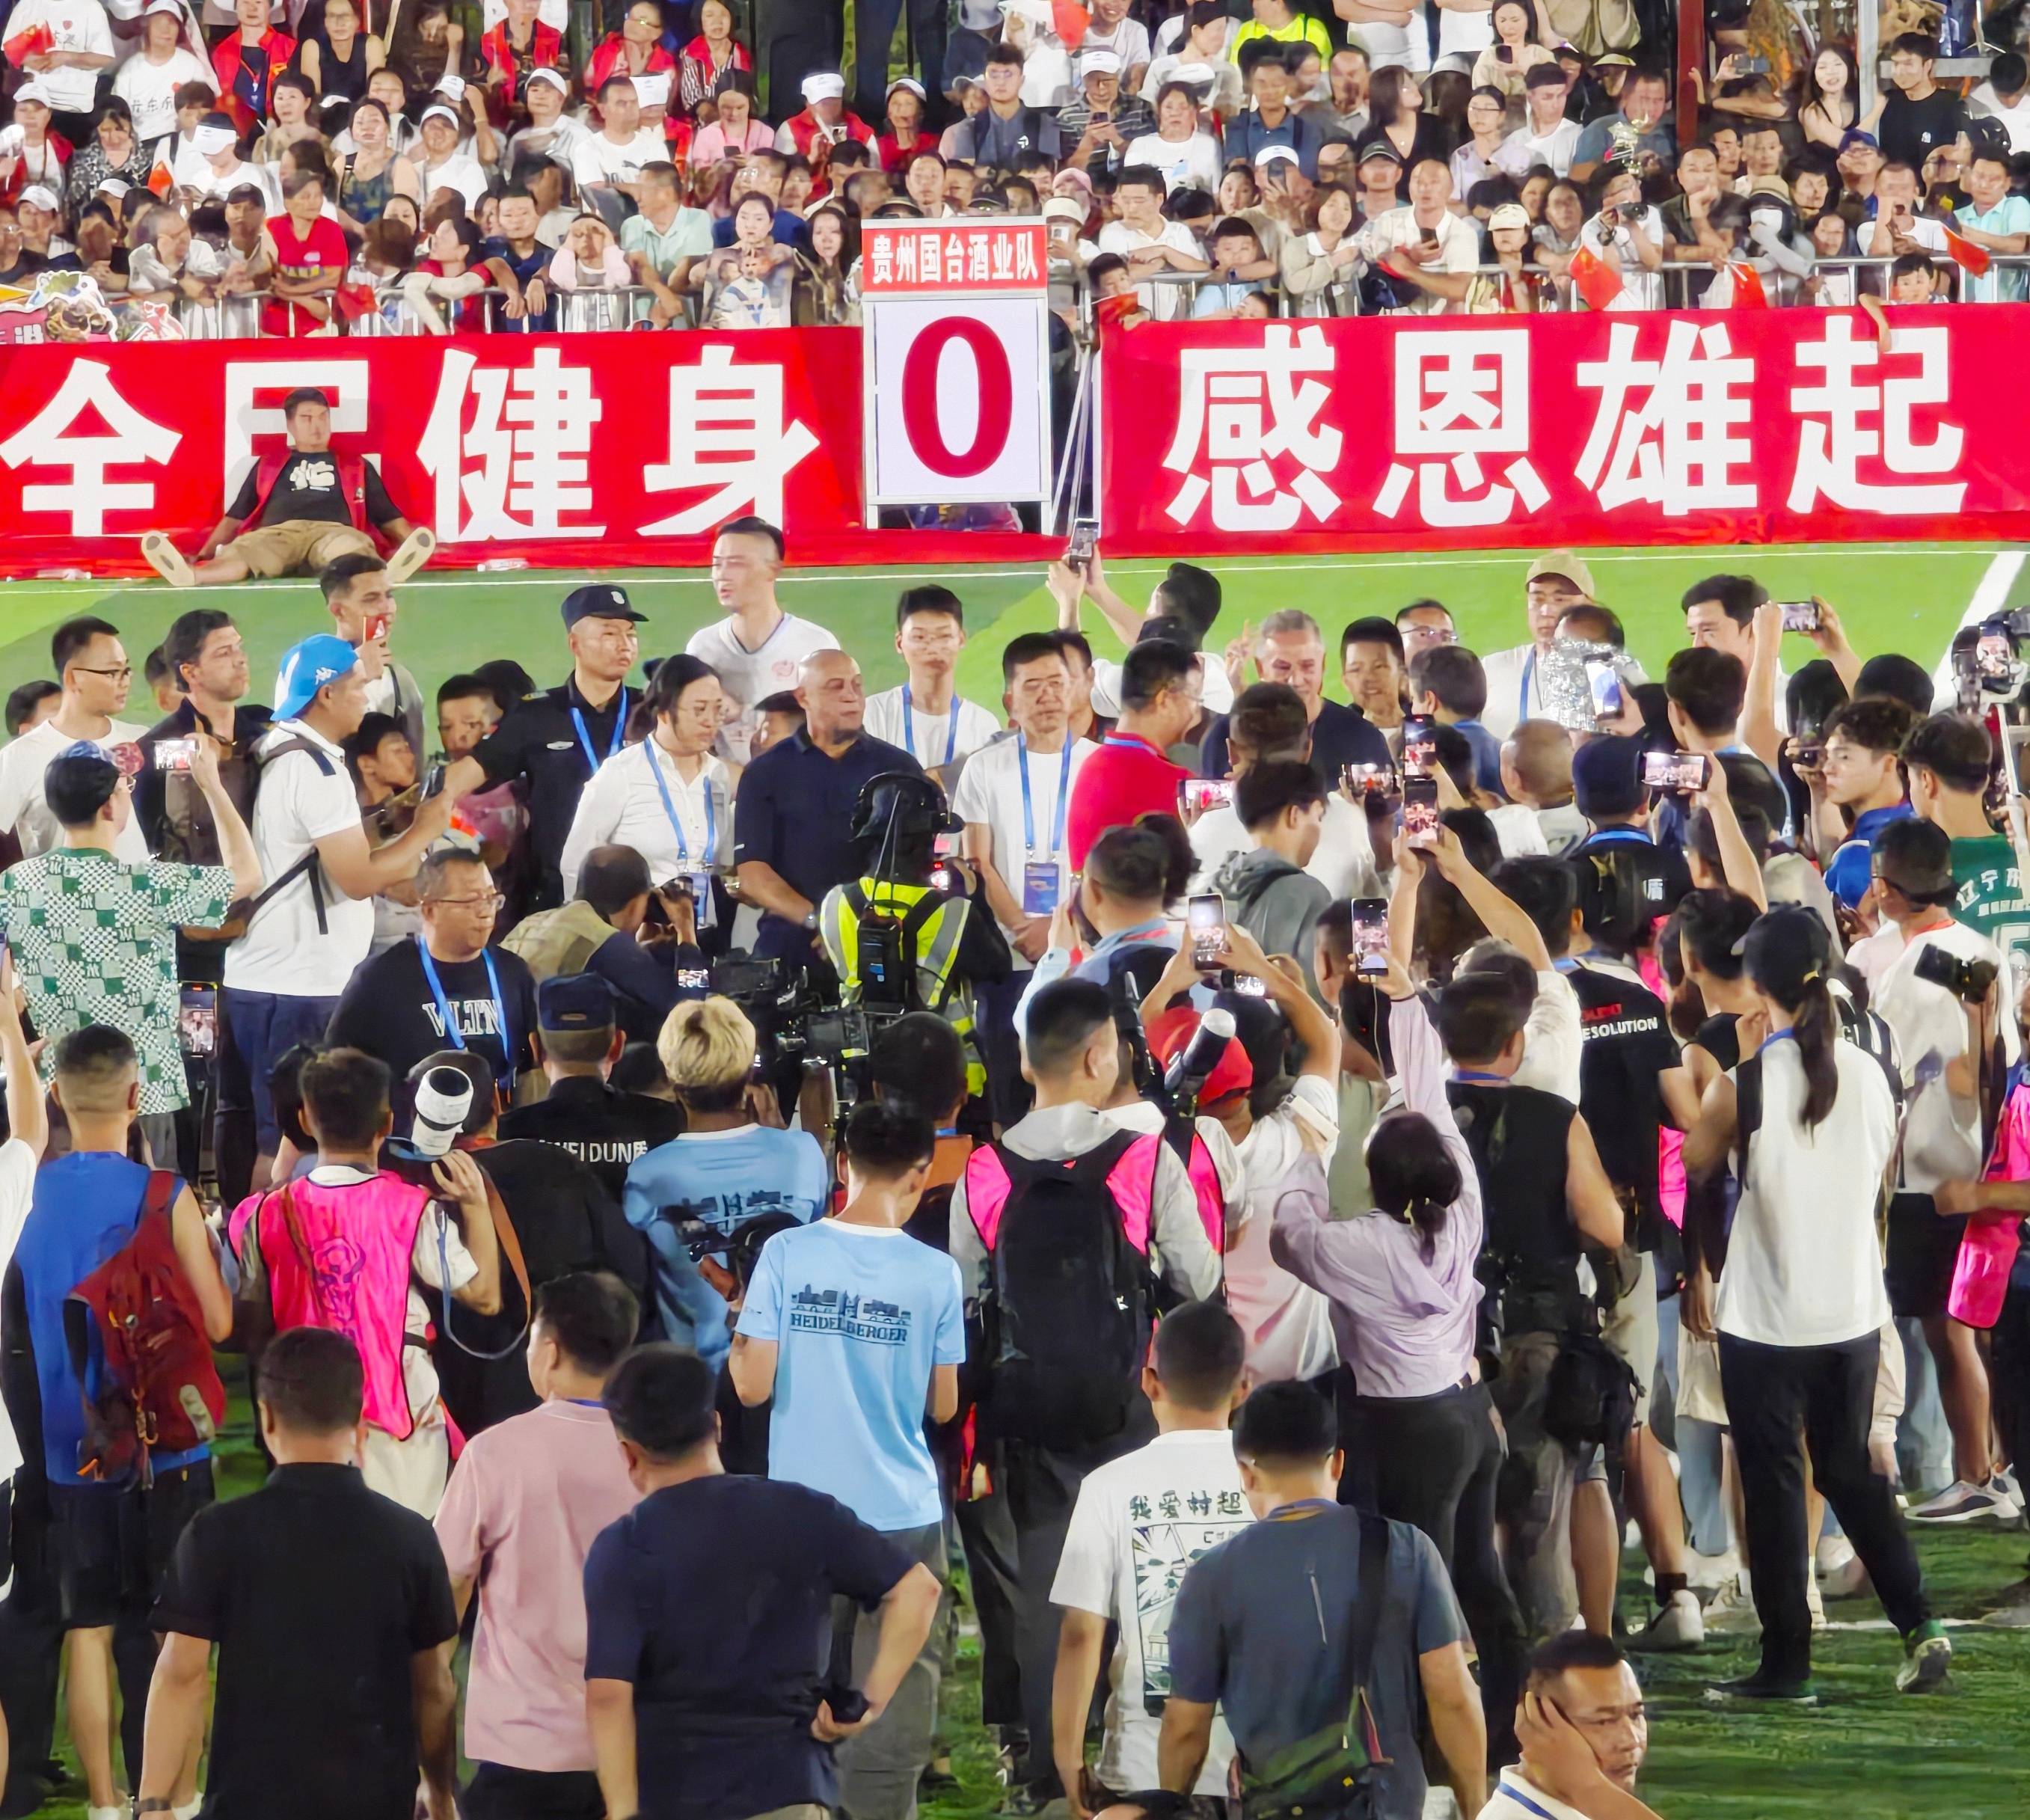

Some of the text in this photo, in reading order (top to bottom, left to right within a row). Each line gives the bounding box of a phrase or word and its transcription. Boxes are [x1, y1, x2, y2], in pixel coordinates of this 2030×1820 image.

[871, 230, 1039, 284] 贵州国台酒业队
[902, 316, 1013, 478] 0
[1162, 314, 1968, 532] 感恩雄起
[1581, 1017, 1658, 1041] ESOLUTION
[1129, 1490, 1243, 1521] 我爱村超
